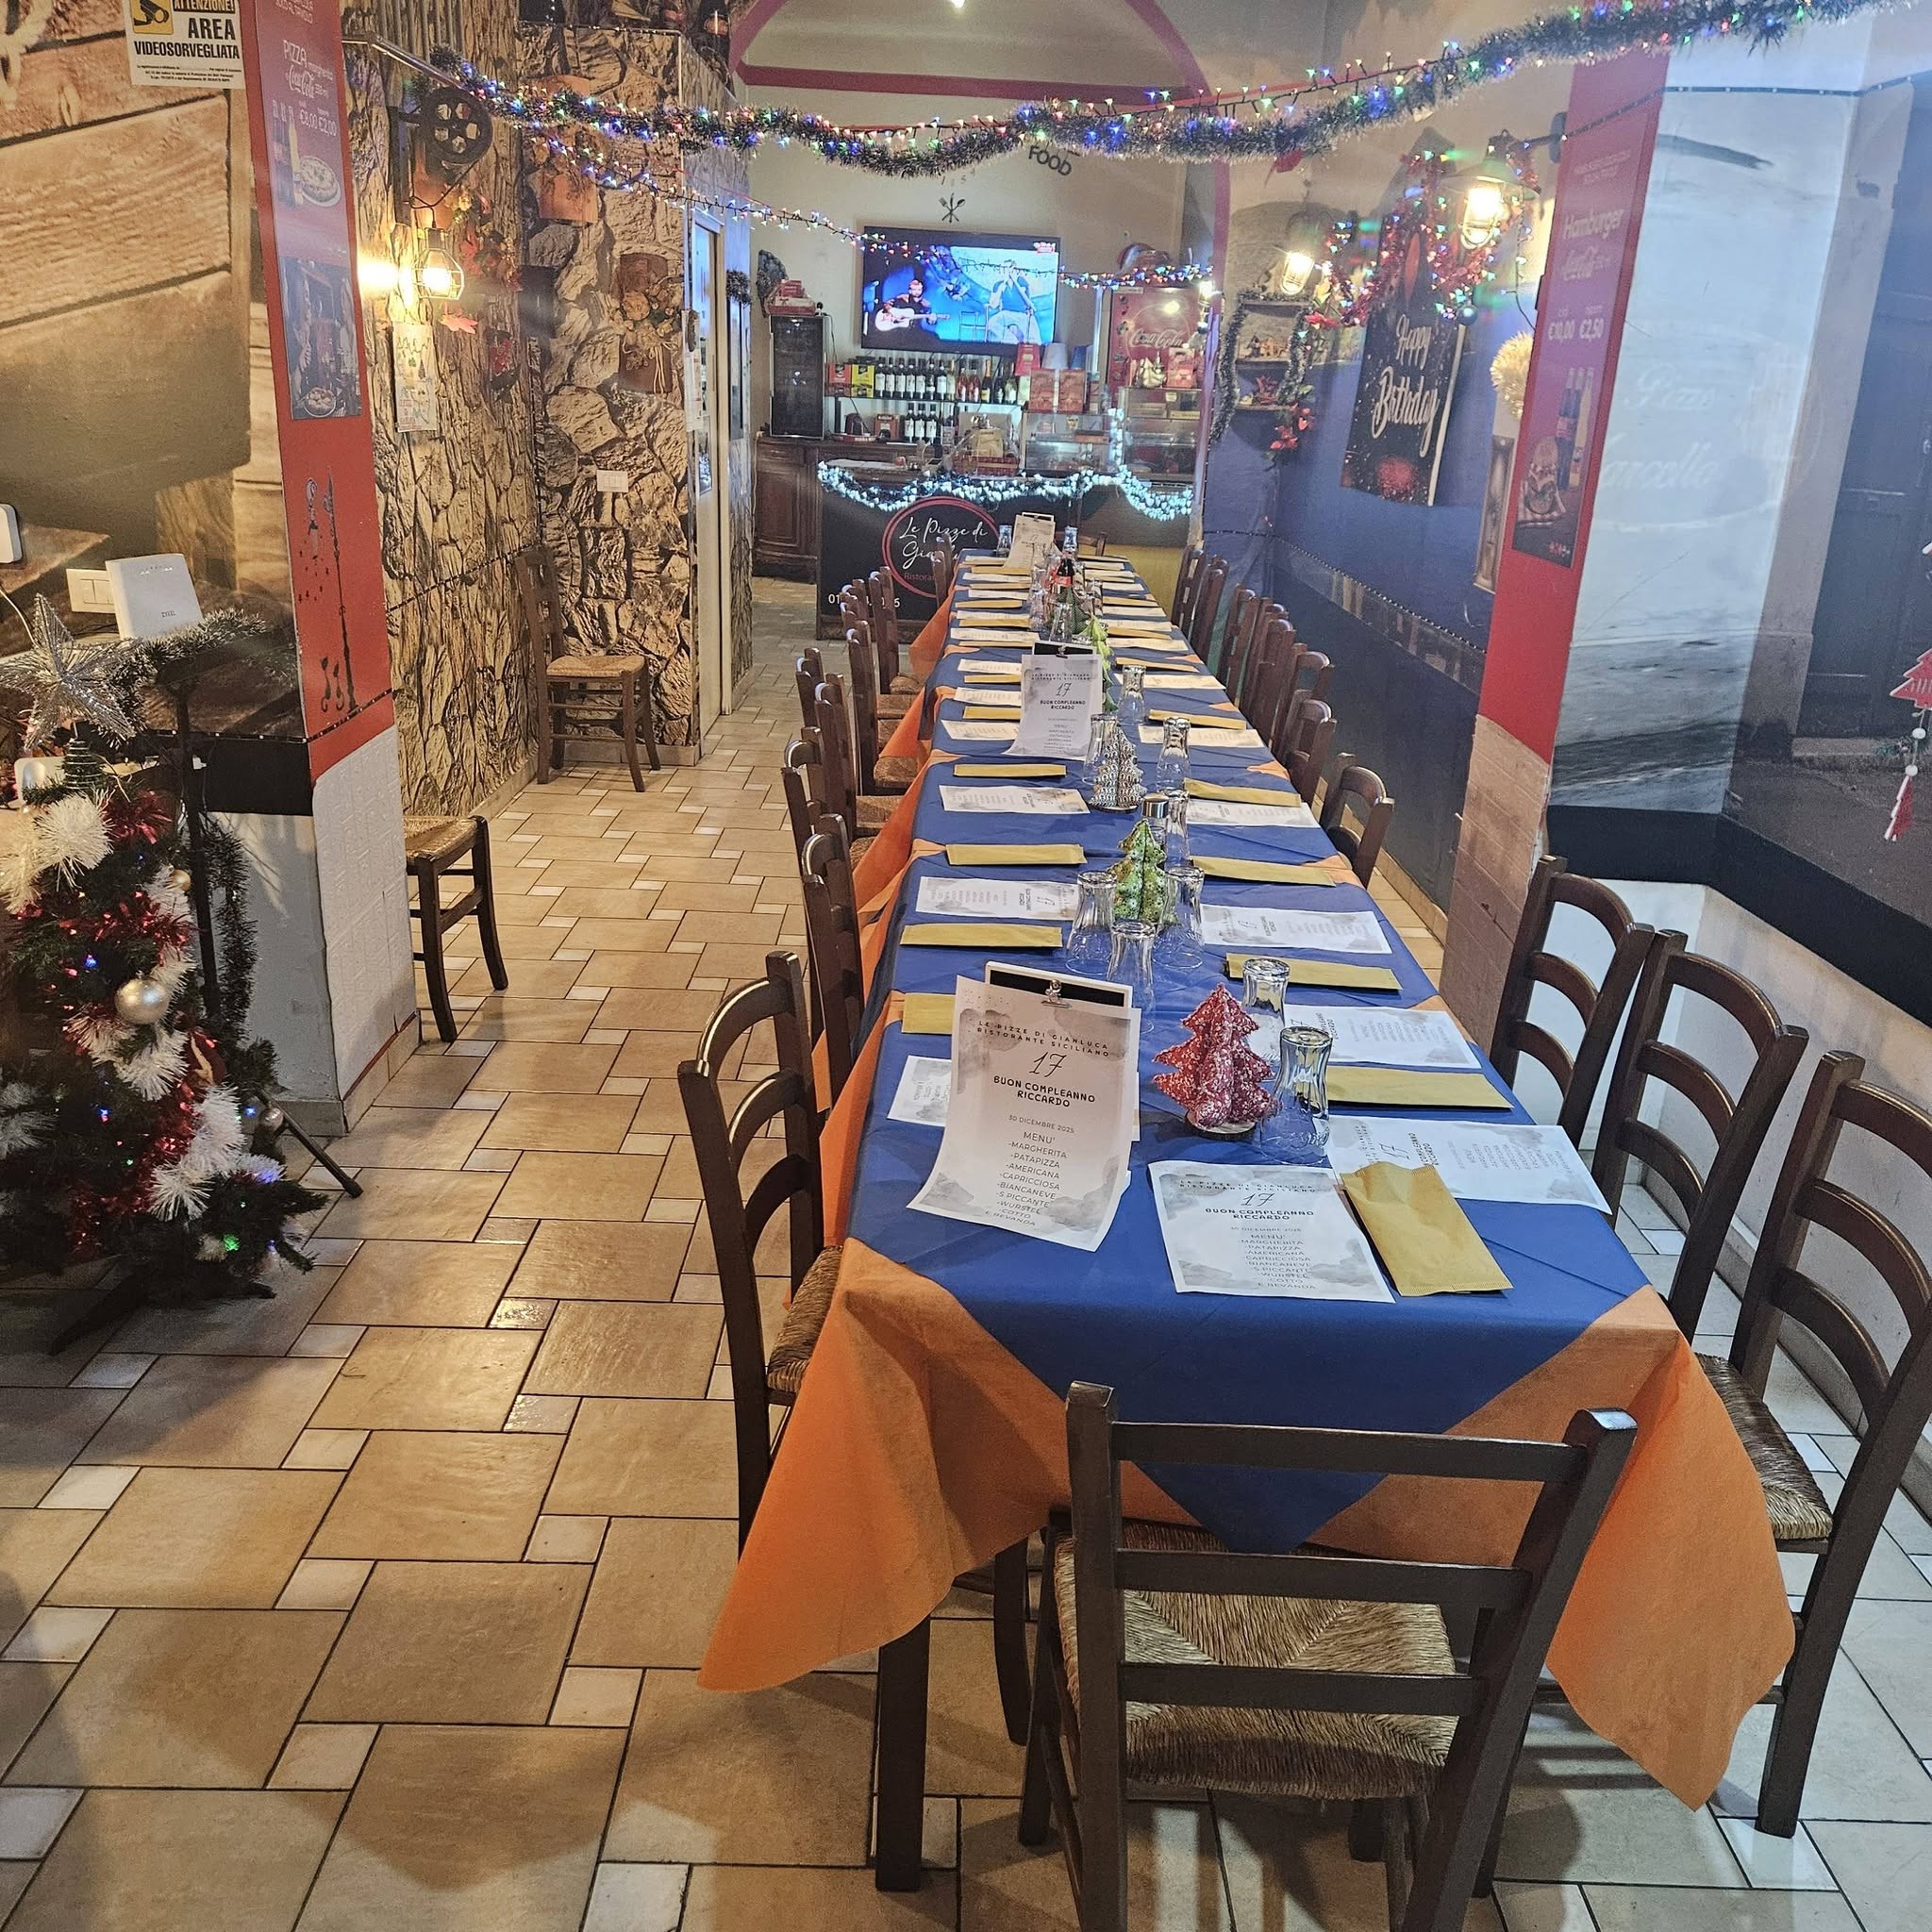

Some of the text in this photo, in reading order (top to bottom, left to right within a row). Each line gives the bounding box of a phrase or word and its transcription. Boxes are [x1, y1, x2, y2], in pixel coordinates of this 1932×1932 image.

[188, 17, 236, 40] AREA
[134, 41, 240, 59] VIDEOSORVEGLIATA
[283, 39, 308, 68] PIZZA
[1028, 144, 1073, 176] FOOD
[1396, 313, 1432, 371] Happy
[1372, 365, 1441, 458] Birthday
[899, 516, 921, 540] Le
[972, 521, 989, 543] di
[1056, 682, 1072, 697] 17
[976, 1026, 1109, 1058] RISTORANTE SICILIANO
[997, 1024, 1028, 1035] PIZZE
[1034, 1030, 1046, 1039] DI
[1052, 1034, 1108, 1050] GIANLUCA
[1028, 1051, 1068, 1078] 17
[993, 1075, 1096, 1103] BUON COMPLEANNO
[1017, 1090, 1071, 1108] RICCARDO
[1019, 1117, 1056, 1130] DICEMBRE
[1057, 1124, 1075, 1134] 2025
[1023, 1131, 1056, 1144] MENU'
[1008, 1141, 1068, 1159] -MARGHERITA
[1010, 1152, 1060, 1169] -PATAPIZZA
[1005, 1162, 1060, 1179] -AMERICANA
[996, 1181, 1057, 1200] -BIANCANEVE
[999, 1172, 1060, 1191] -CAPRICCIOSA
[997, 1200, 1041, 1215] -WURSTEL
[1007, 1192, 1051, 1208] PICCANTE
[1241, 1192, 1275, 1207] 17
[1239, 1208, 1315, 1217] COMPLEANNO
